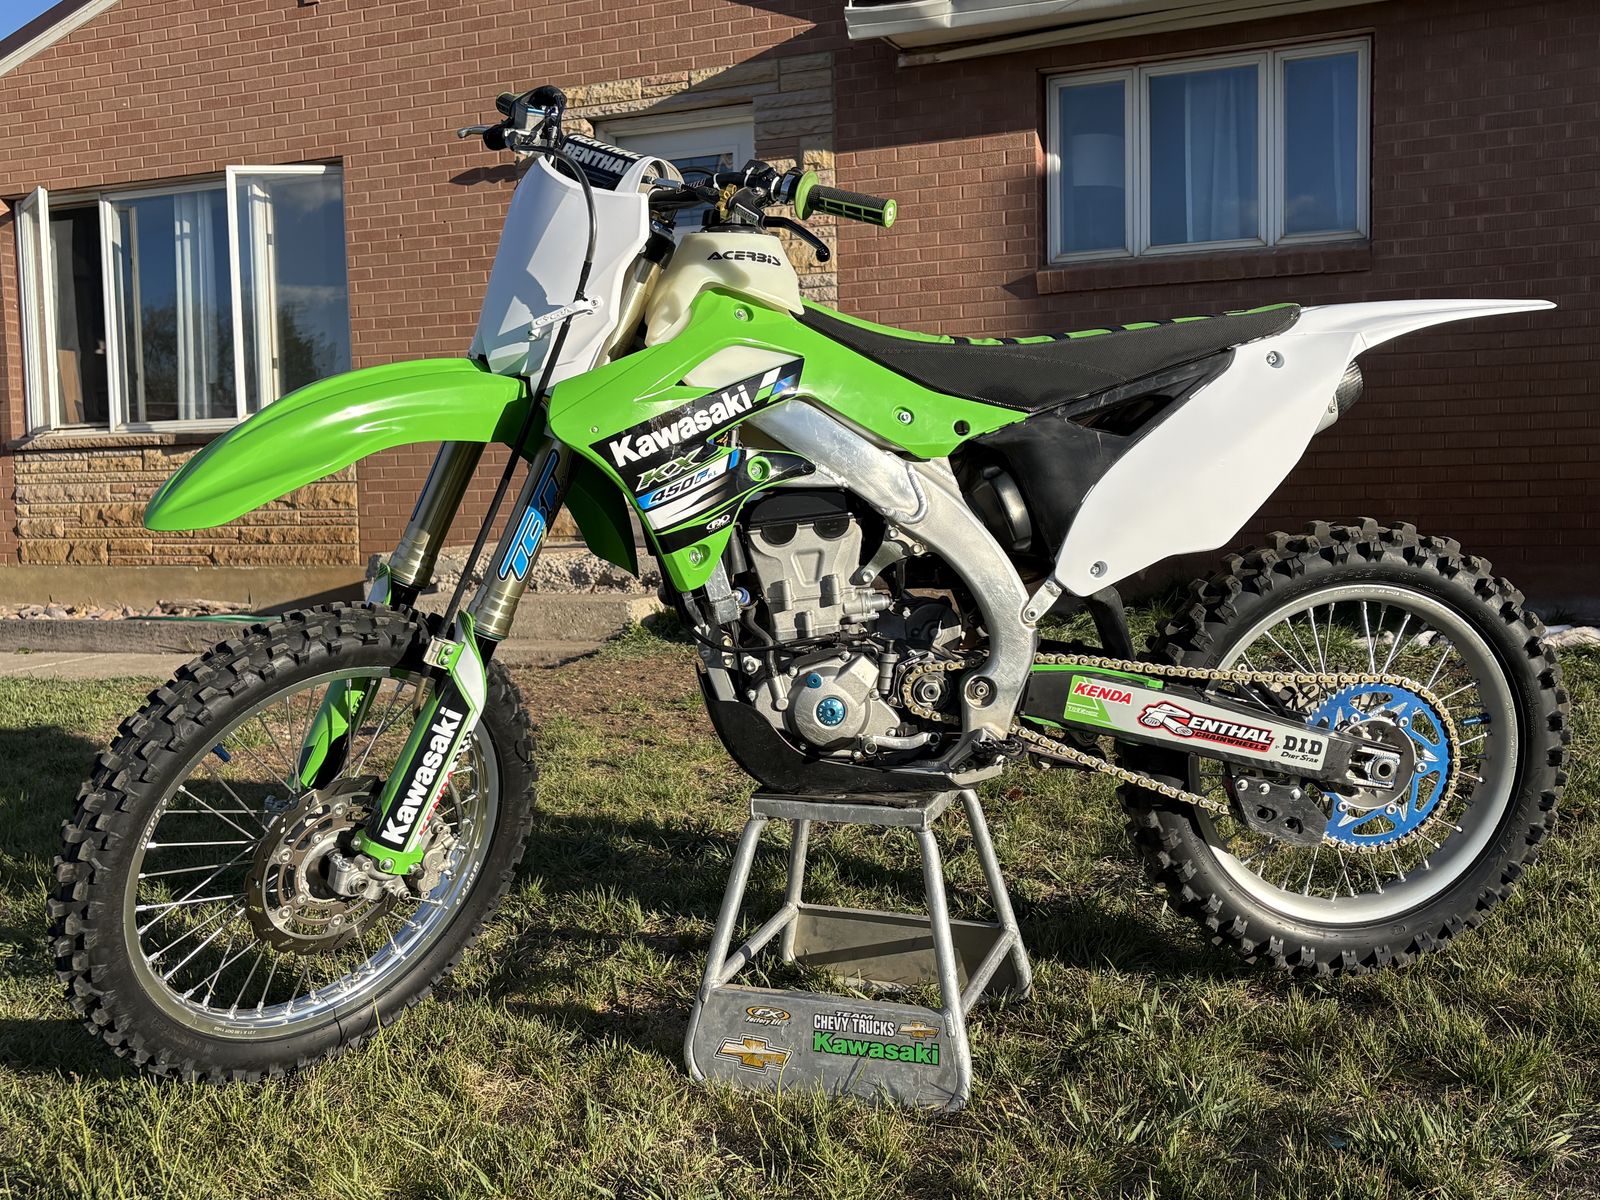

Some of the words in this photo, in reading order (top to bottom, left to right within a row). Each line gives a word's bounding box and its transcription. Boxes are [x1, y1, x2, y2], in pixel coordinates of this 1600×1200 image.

[609, 384, 753, 468] Kawasaki
[635, 445, 704, 492] KX
[1074, 681, 1133, 705] KENDA
[1194, 731, 1268, 751] CHAINWHEELS
[1282, 735, 1323, 756] D.I.D
[380, 706, 464, 845] Kawasaki
[813, 1013, 850, 1033] CHEVY
[852, 1018, 896, 1038] TRUCKS
[835, 1010, 874, 1021] TEAM
[812, 1030, 941, 1067] Kawasaki
